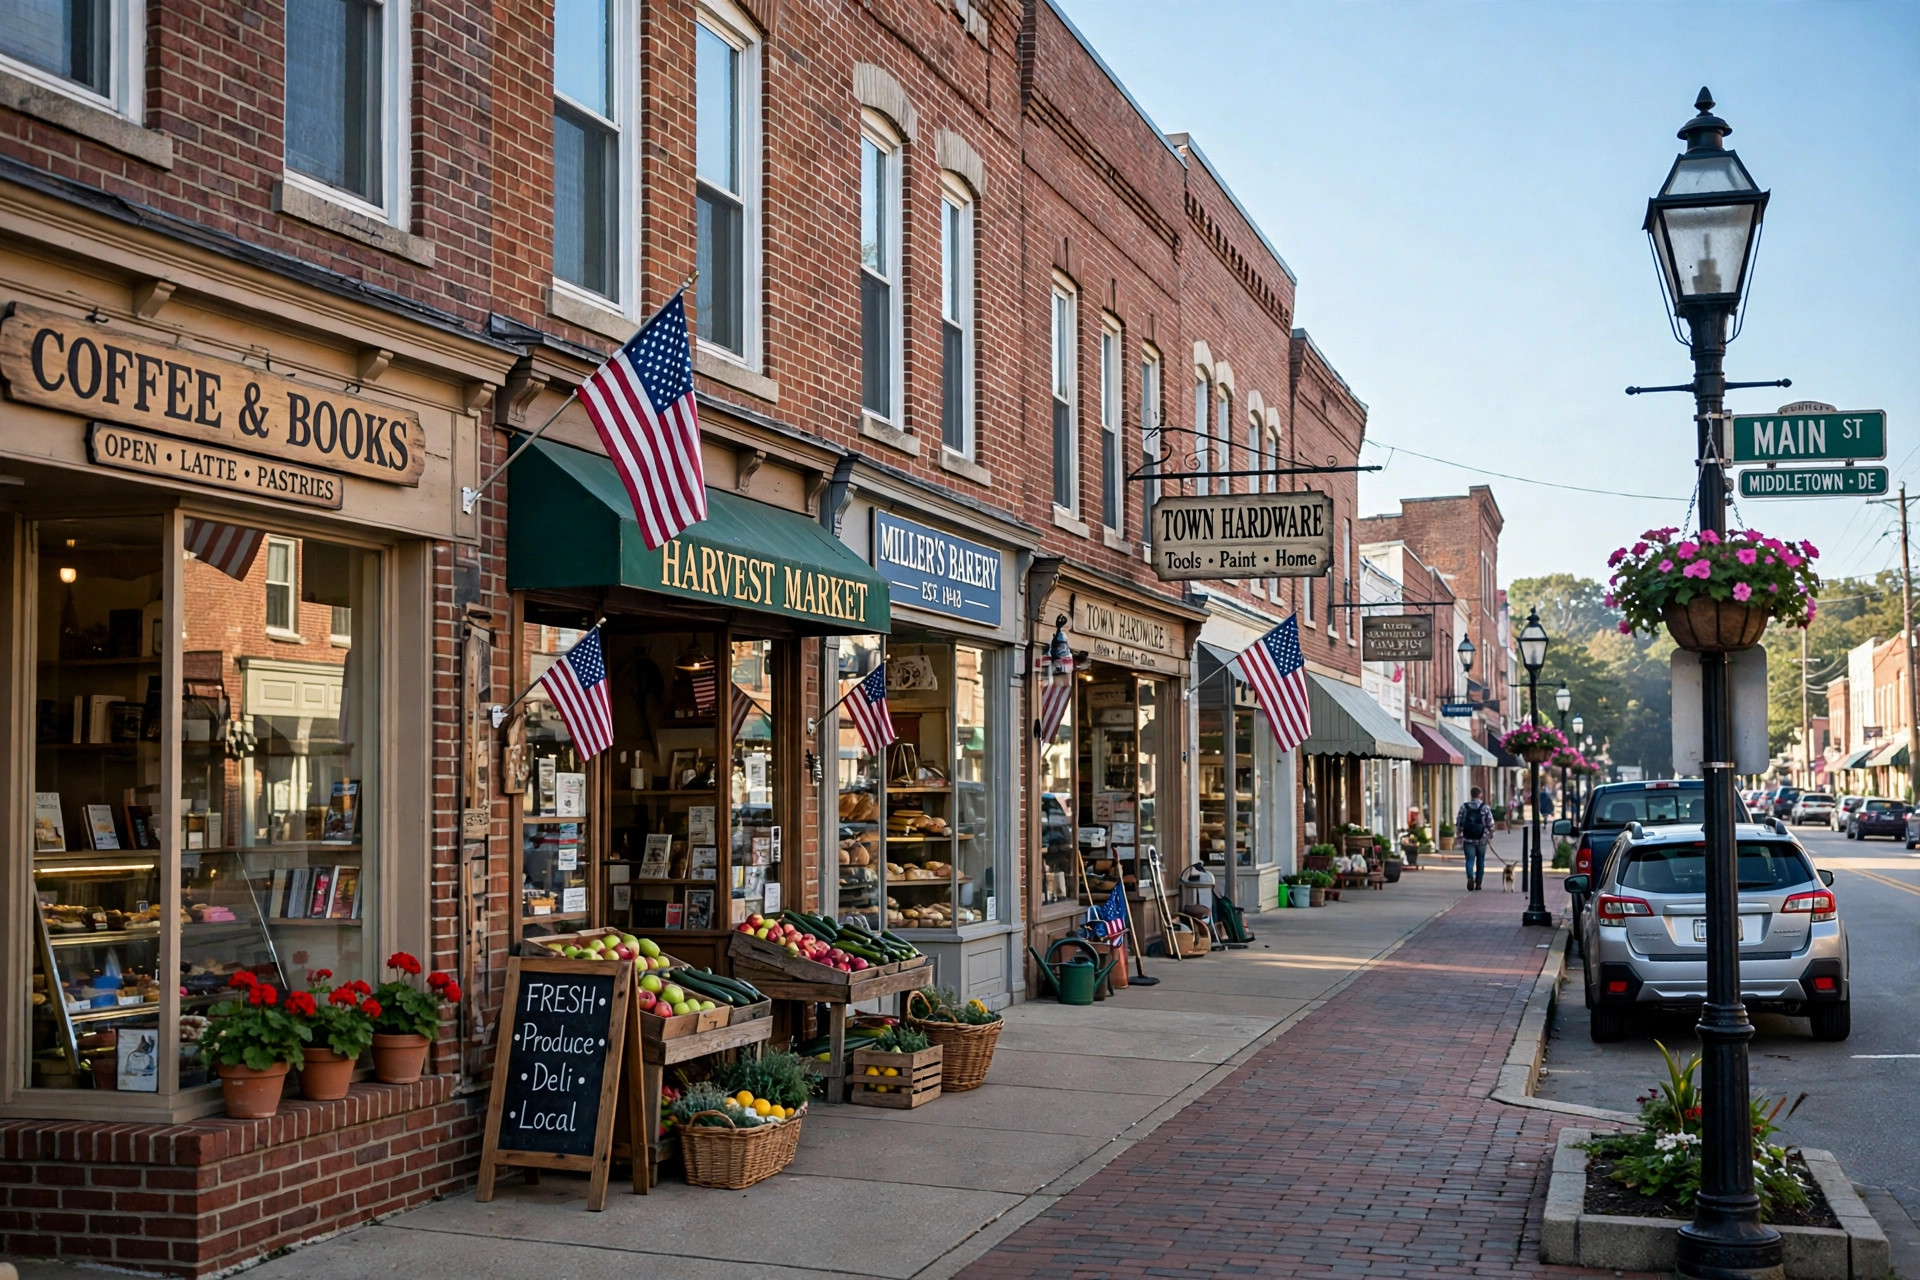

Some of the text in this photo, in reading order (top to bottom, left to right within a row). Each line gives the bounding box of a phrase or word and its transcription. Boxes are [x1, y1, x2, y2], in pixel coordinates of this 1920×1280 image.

[31, 328, 409, 472] COFFEE & BOOKS
[1754, 419, 1863, 456] MAIN ST
[105, 433, 334, 501] OPEN LATTE PASTRIES
[1750, 472, 1877, 492] MIDDLETOWN DE
[1161, 504, 1324, 541] TOWN HARDWARE
[880, 522, 945, 576] MILLER'S
[1165, 549, 1317, 569] Tools Paint Home
[661, 539, 868, 623] HARVEST MARKET
[1087, 603, 1115, 636] TOWN
[526, 983, 597, 1015] FRESH
[522, 1023, 594, 1055] Produce
[532, 1062, 573, 1092] Deli
[519, 1100, 577, 1132] Local
